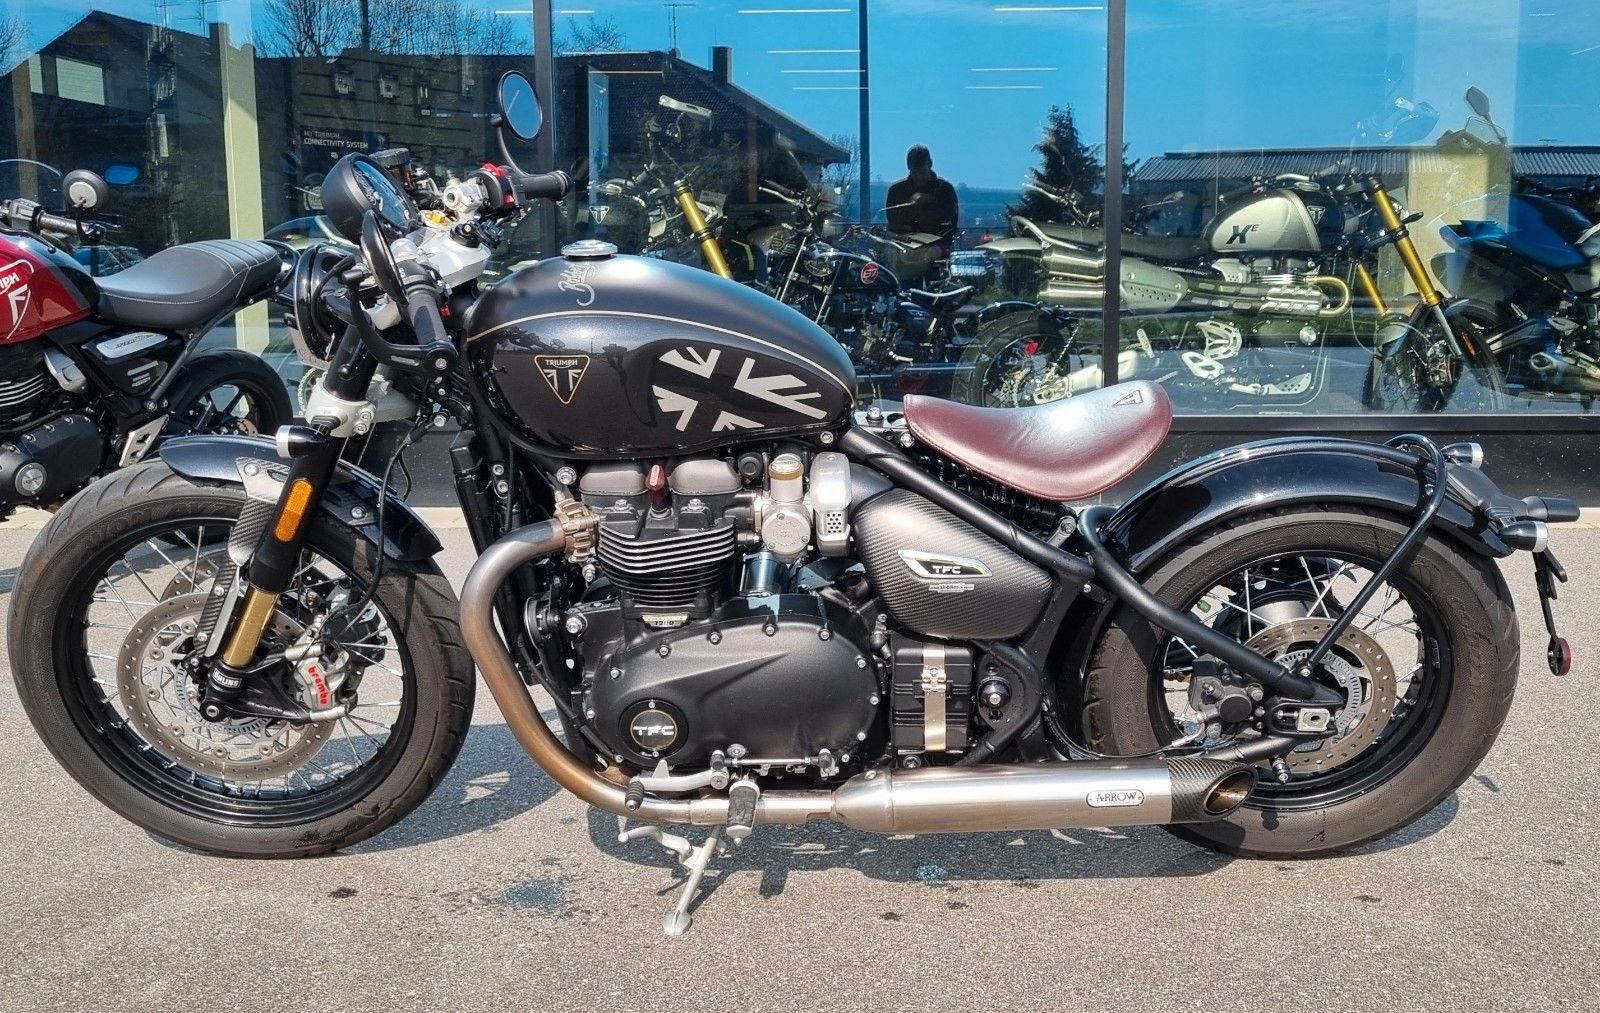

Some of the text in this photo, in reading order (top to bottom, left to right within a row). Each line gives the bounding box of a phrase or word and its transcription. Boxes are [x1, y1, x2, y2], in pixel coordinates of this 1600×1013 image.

[304, 138, 369, 149] CONNECTIVITY SYSTEM
[545, 359, 578, 368] TRIUMPH
[932, 565, 961, 575] TFC
[307, 665, 328, 705] brembo
[633, 725, 675, 736] TFC
[1096, 791, 1137, 802] ARROW
